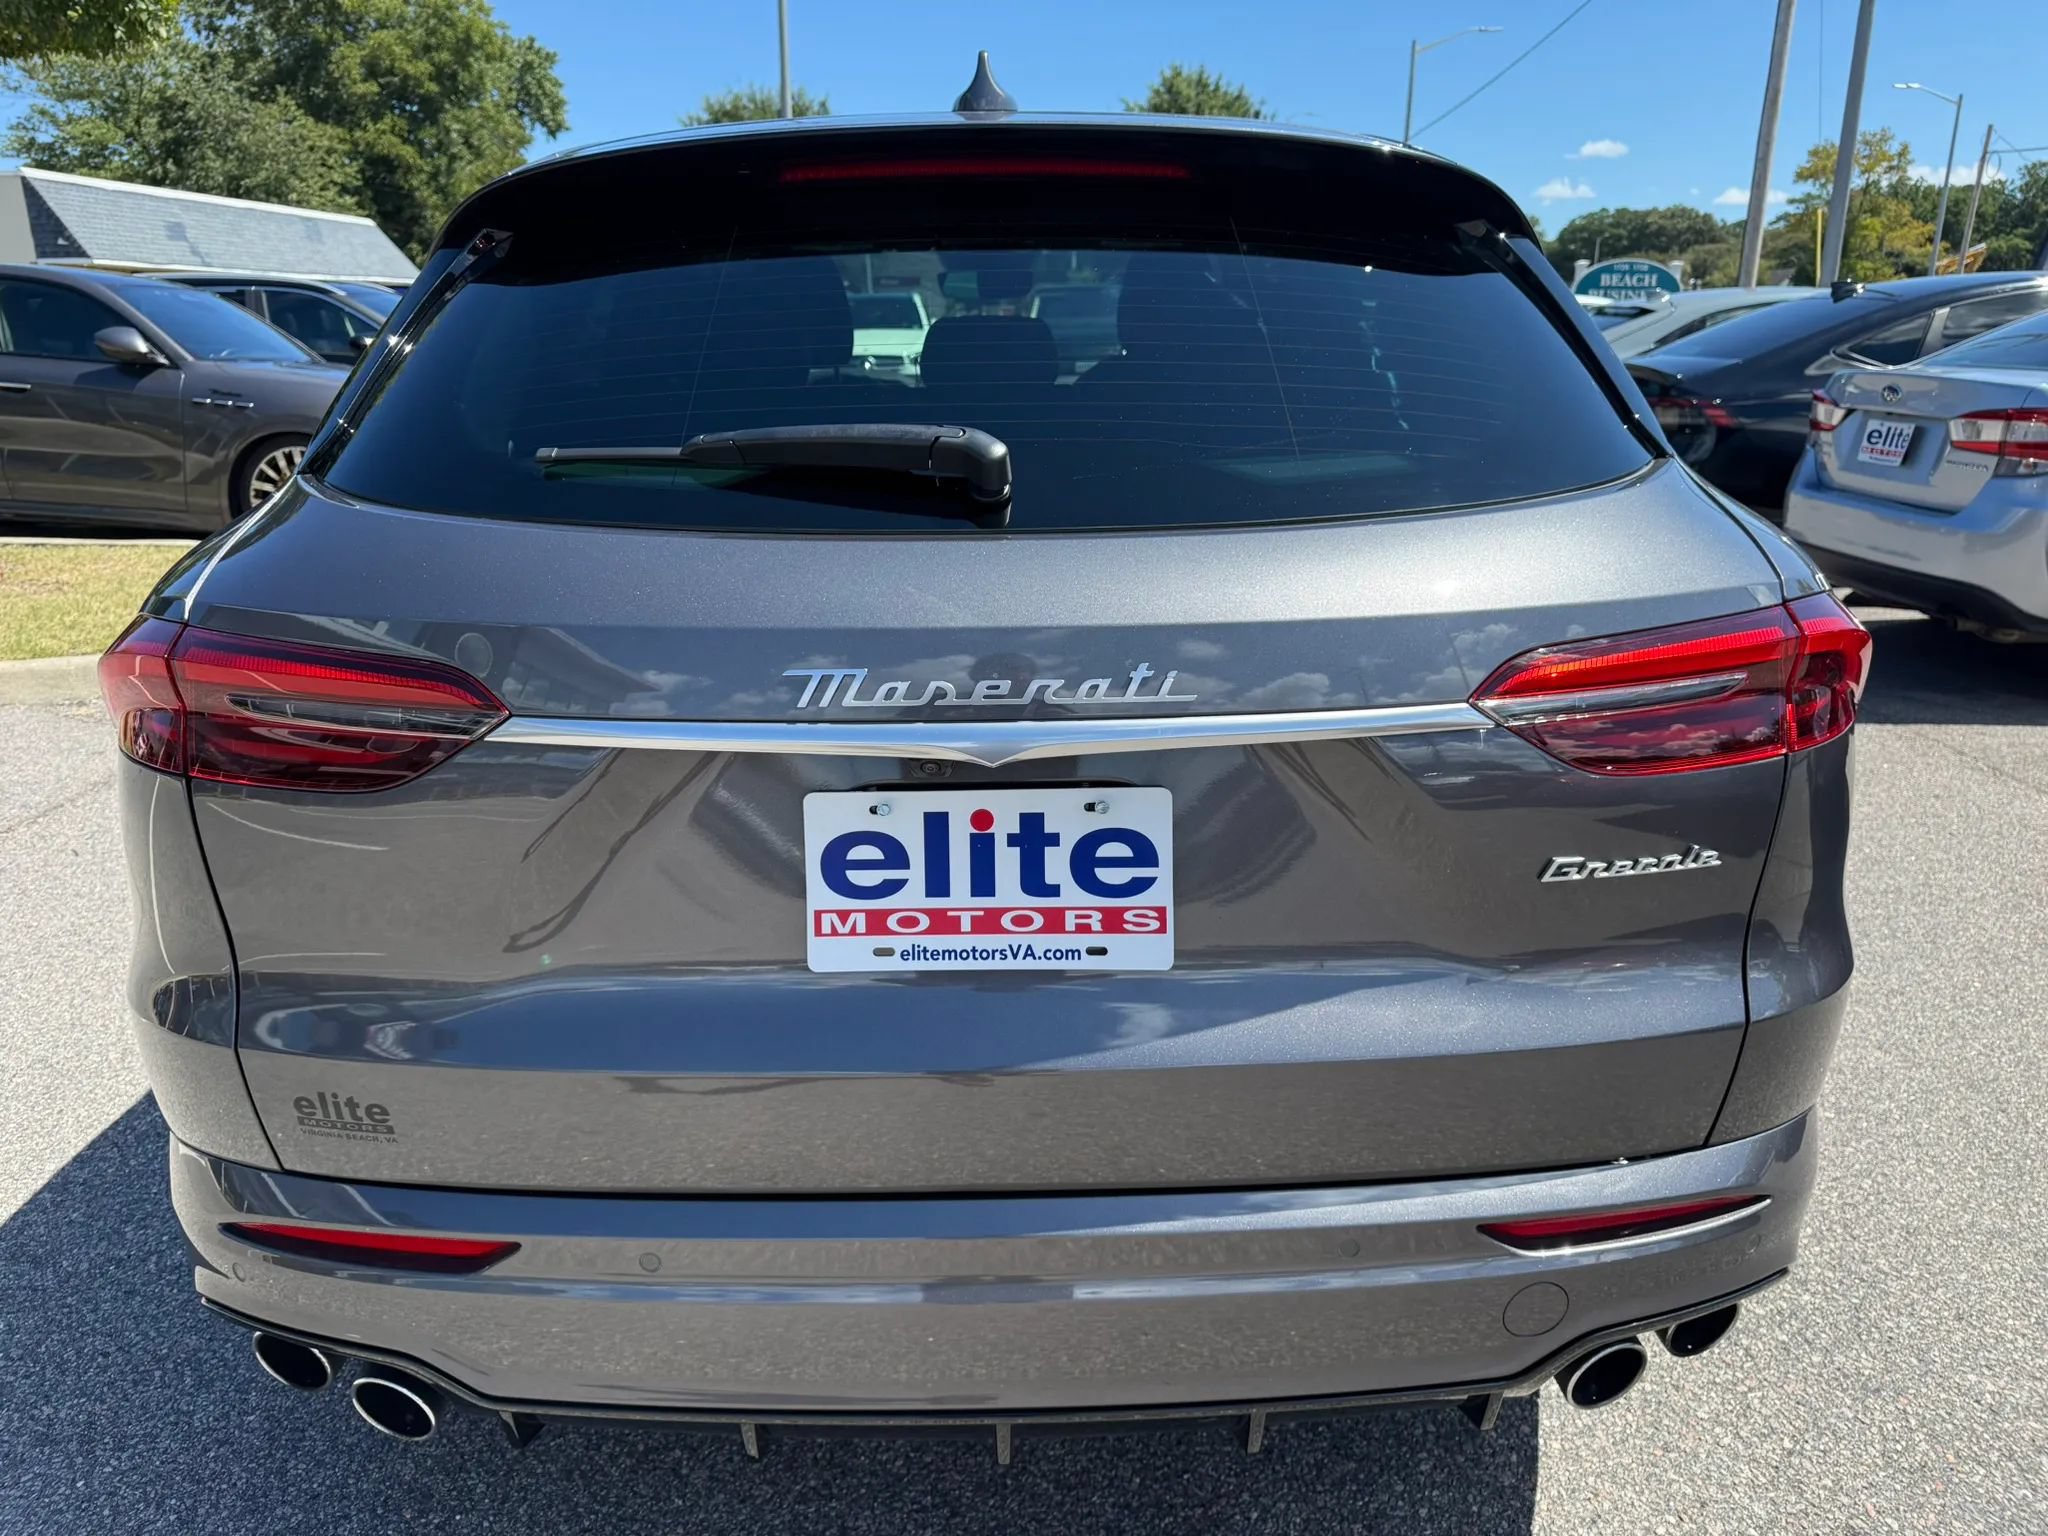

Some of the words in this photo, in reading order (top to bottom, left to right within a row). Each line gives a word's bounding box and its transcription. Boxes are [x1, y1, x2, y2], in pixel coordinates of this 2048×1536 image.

[1600, 273, 1658, 287] BEACH
[1866, 426, 1910, 449] elite
[782, 663, 1198, 708] Maserati
[820, 808, 1160, 900] elite
[1540, 843, 1722, 883] Grecale
[820, 909, 1161, 935] MOTORS
[899, 943, 1082, 962] elitemotorsVA.com
[293, 1091, 391, 1124] elite
[300, 1127, 342, 1139] VIRGINIA
[384, 1136, 399, 1144] VA
[303, 1119, 389, 1133] MOTORS
